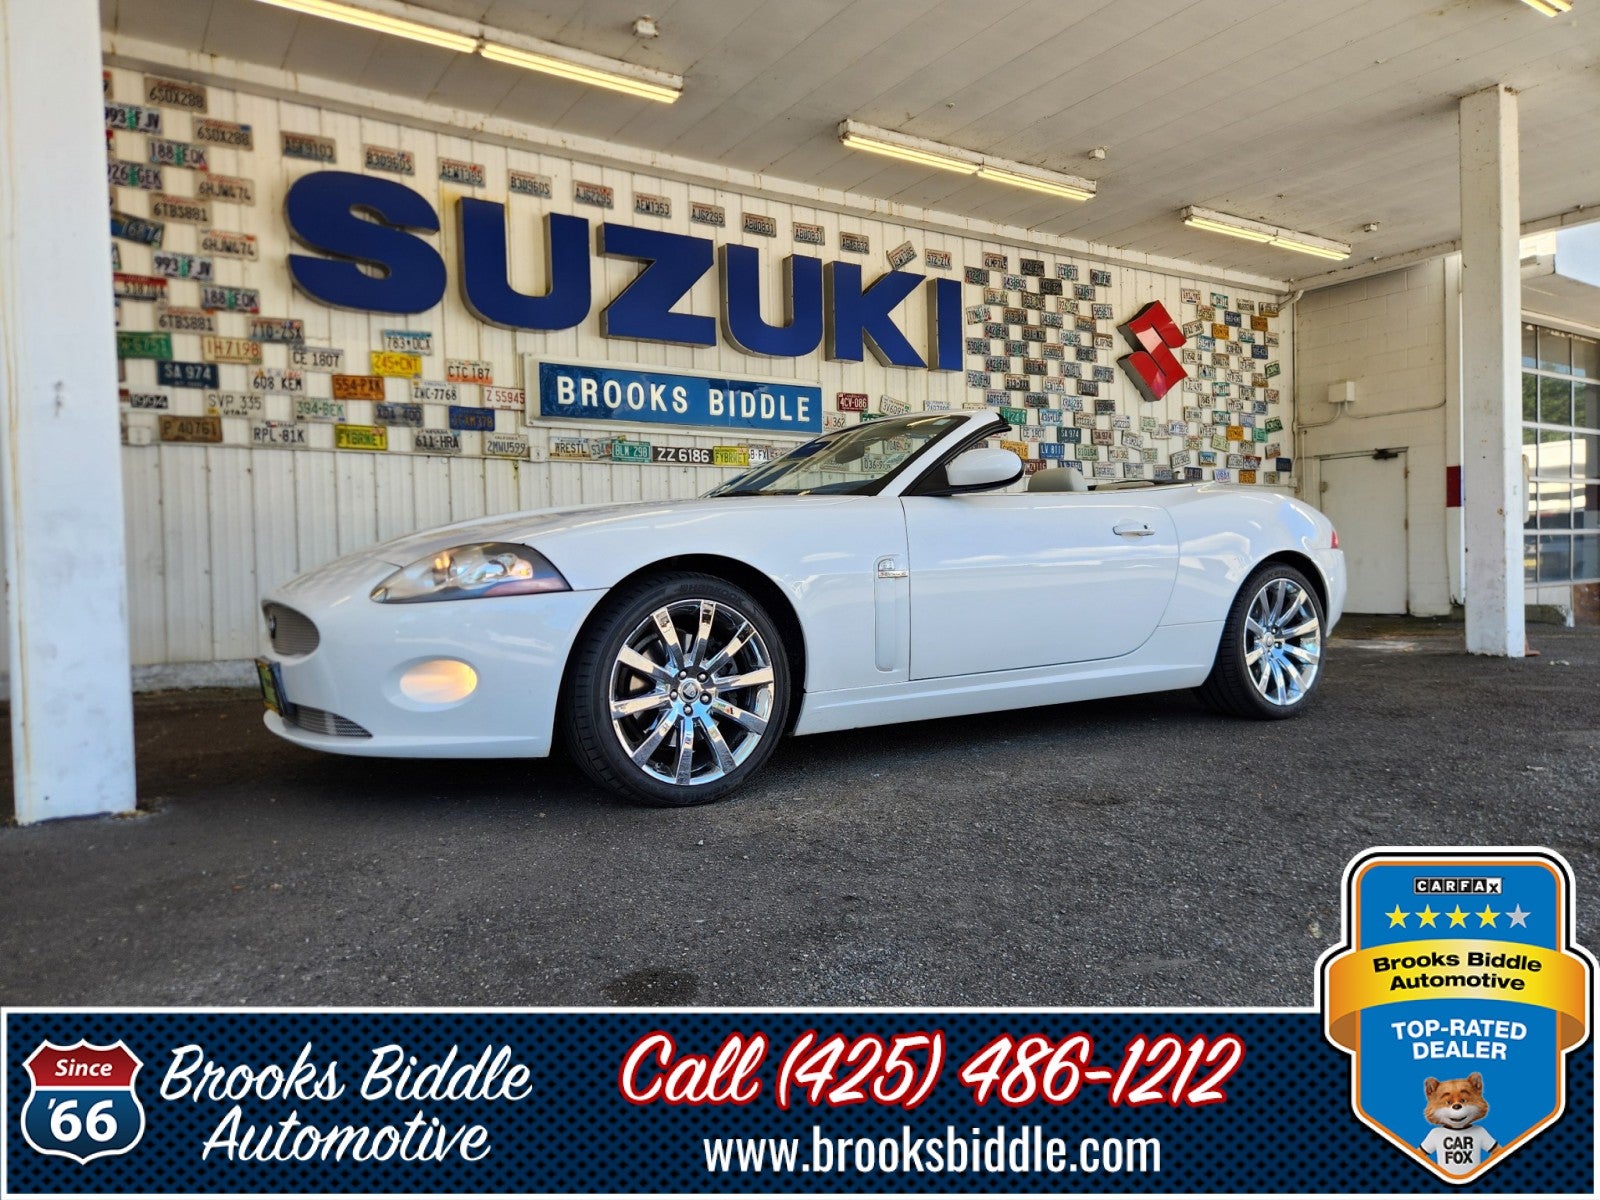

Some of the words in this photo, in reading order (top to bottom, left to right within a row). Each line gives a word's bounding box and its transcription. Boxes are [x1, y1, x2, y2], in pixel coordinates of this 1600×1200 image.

[286, 170, 963, 373] SUZUKI
[185, 364, 212, 380] 974
[556, 375, 688, 415] BROOKS
[708, 388, 811, 422] BIDDLE
[657, 448, 677, 462] ZZ
[678, 449, 710, 463] 6186
